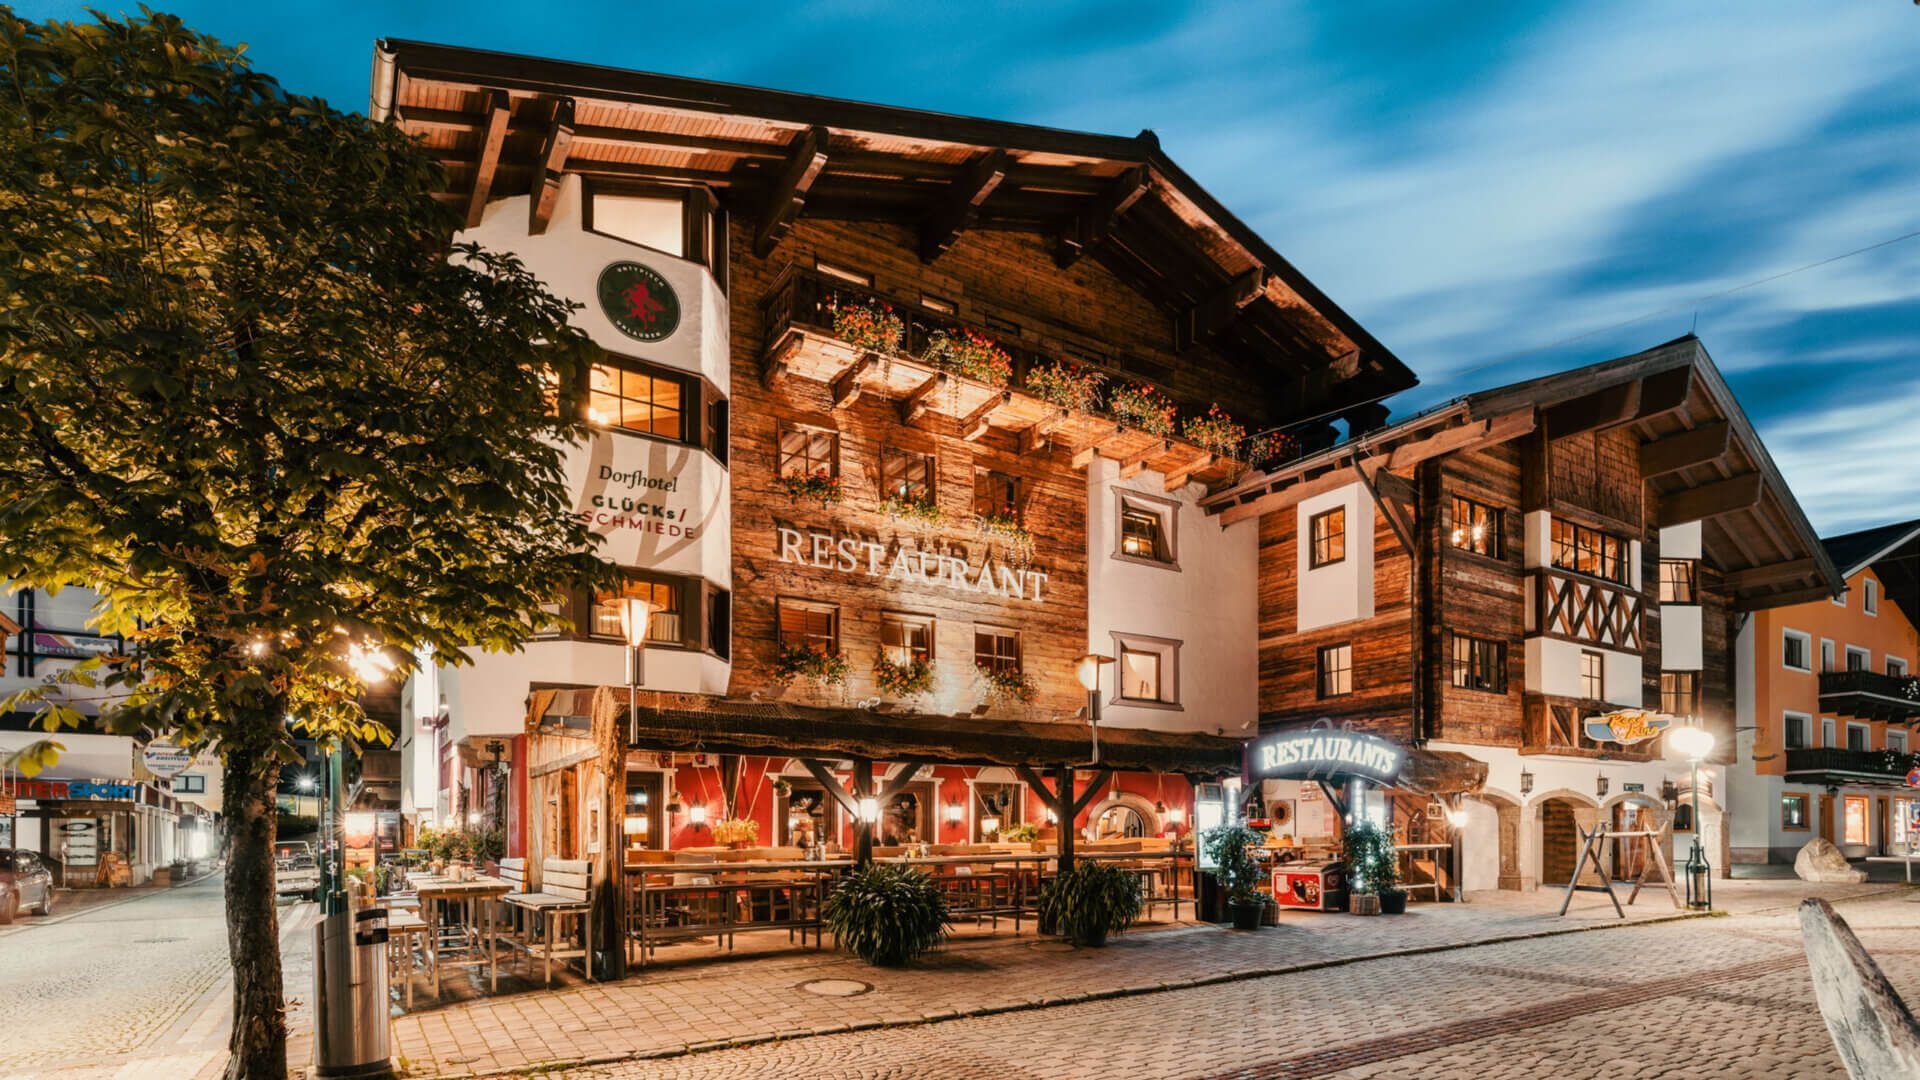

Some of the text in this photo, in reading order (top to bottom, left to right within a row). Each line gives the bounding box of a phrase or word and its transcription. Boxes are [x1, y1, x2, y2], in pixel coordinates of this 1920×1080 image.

[600, 465, 678, 493] Dorfhotel
[582, 510, 695, 539] SCHMIEDE
[777, 527, 1048, 602] RESTAURANT
[1262, 737, 1397, 774] RESTAURANTS
